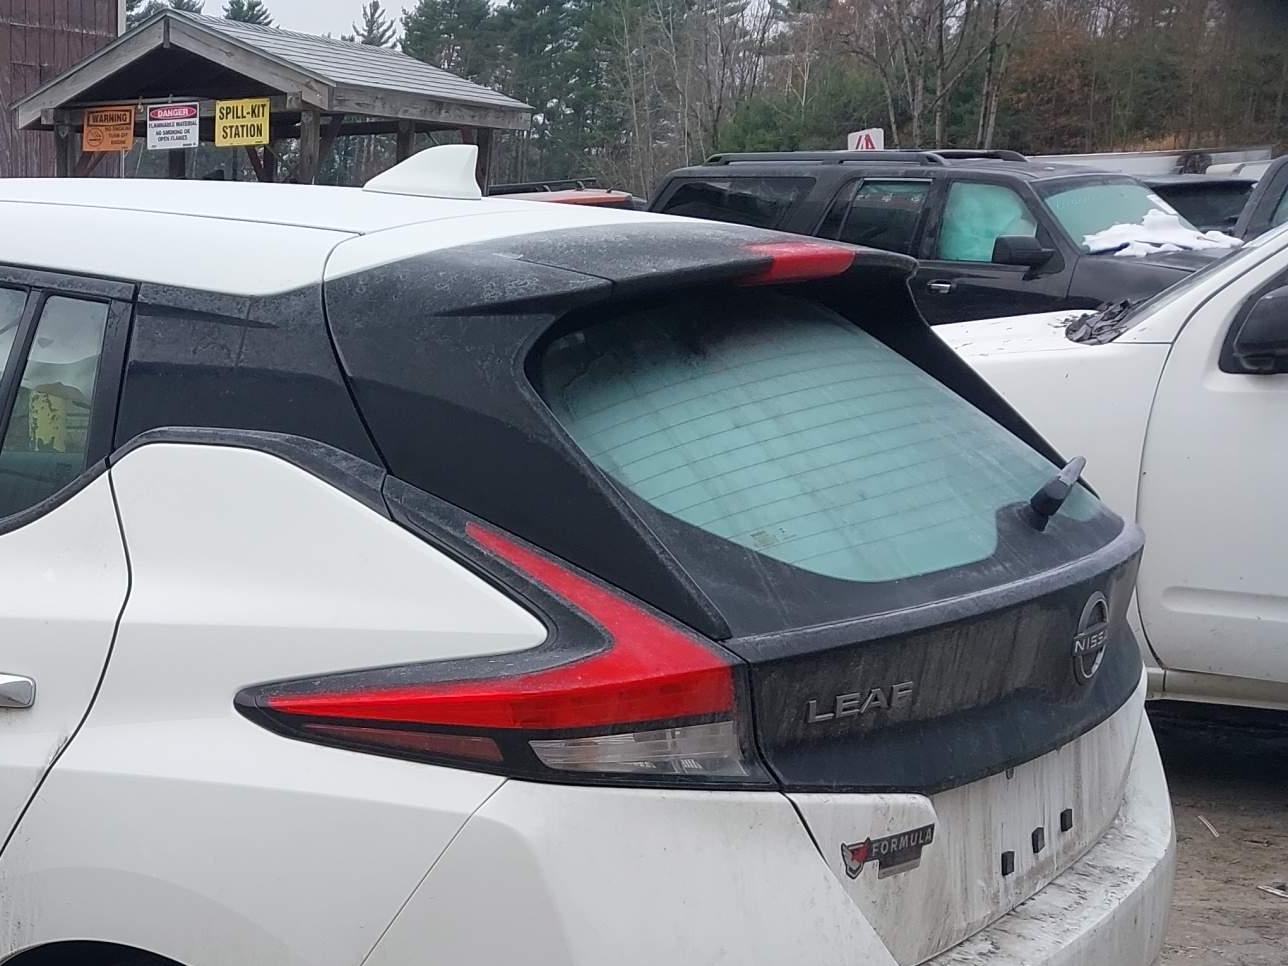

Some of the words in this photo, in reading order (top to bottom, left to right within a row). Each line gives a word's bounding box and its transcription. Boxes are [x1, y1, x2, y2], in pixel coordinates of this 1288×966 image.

[92, 112, 127, 123] WARNING
[157, 108, 189, 118] DANGER
[219, 104, 266, 120] SPILL-KIT
[222, 123, 262, 139] STATION
[808, 681, 913, 723] LEAF
[872, 828, 932, 857] FORMULA
